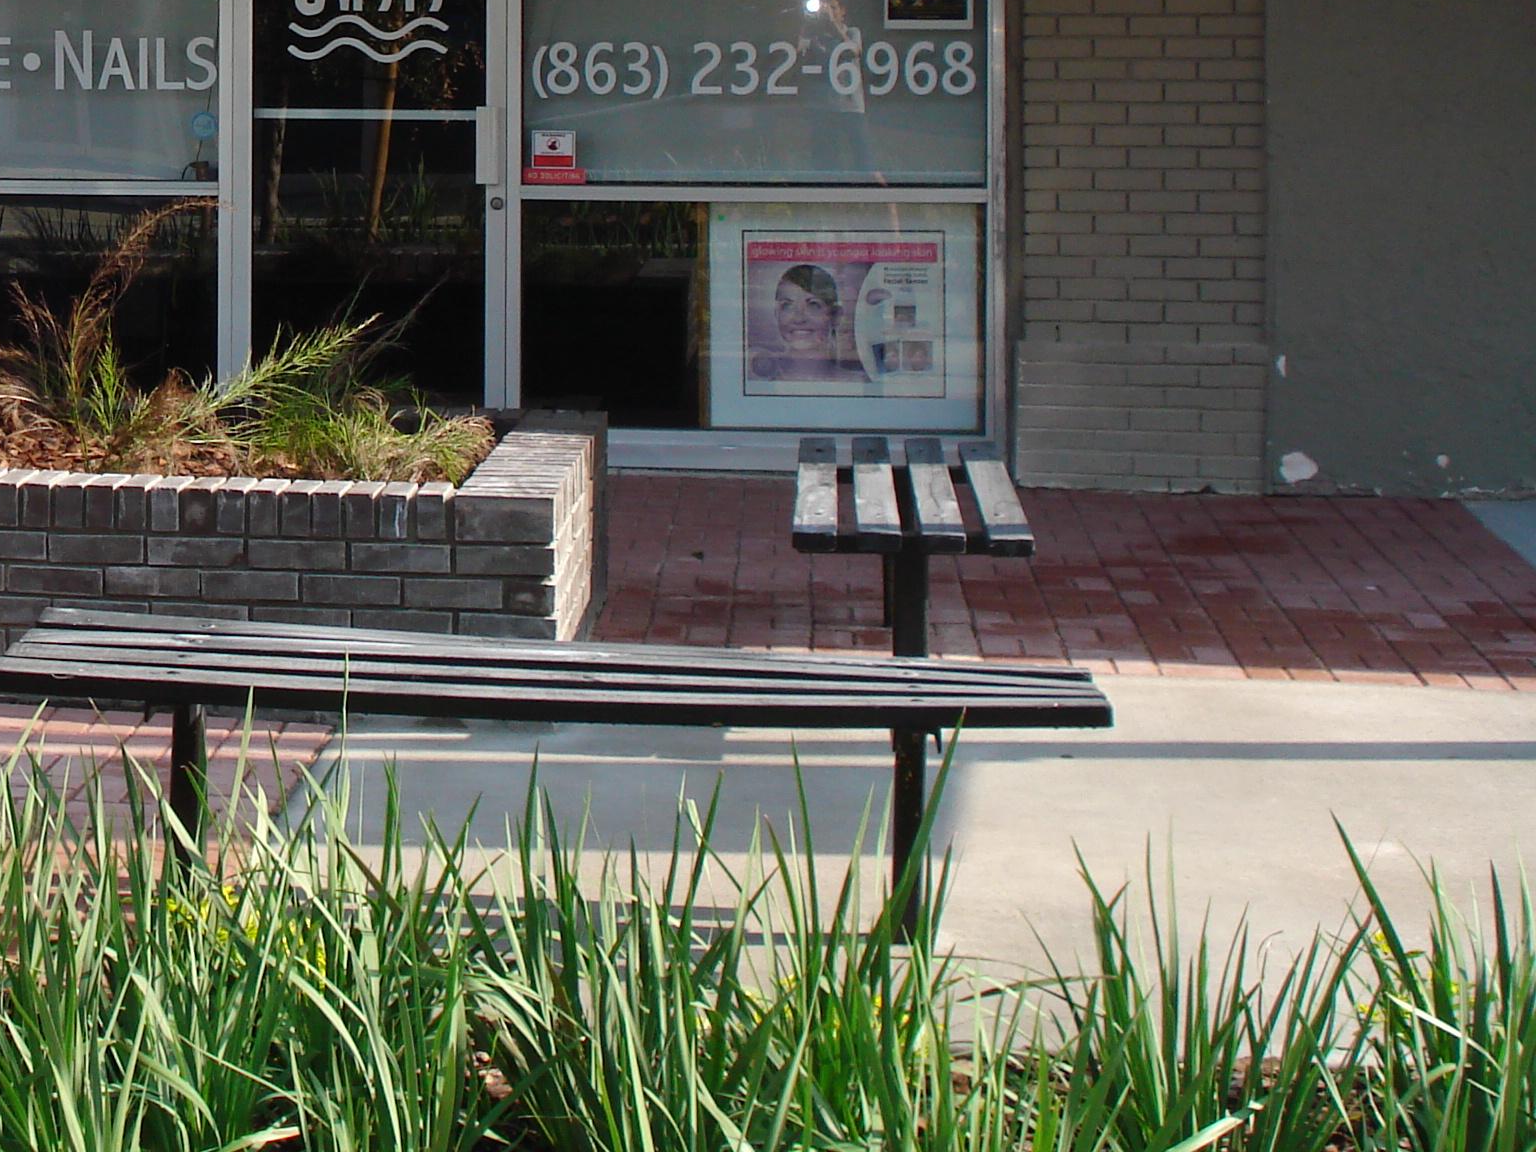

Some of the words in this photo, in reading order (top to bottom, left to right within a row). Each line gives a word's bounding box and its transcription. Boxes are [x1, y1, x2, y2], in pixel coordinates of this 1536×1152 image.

[54, 29, 219, 92] NAILS
[531, 41, 669, 100] (863)
[691, 41, 977, 98] 232-6968
